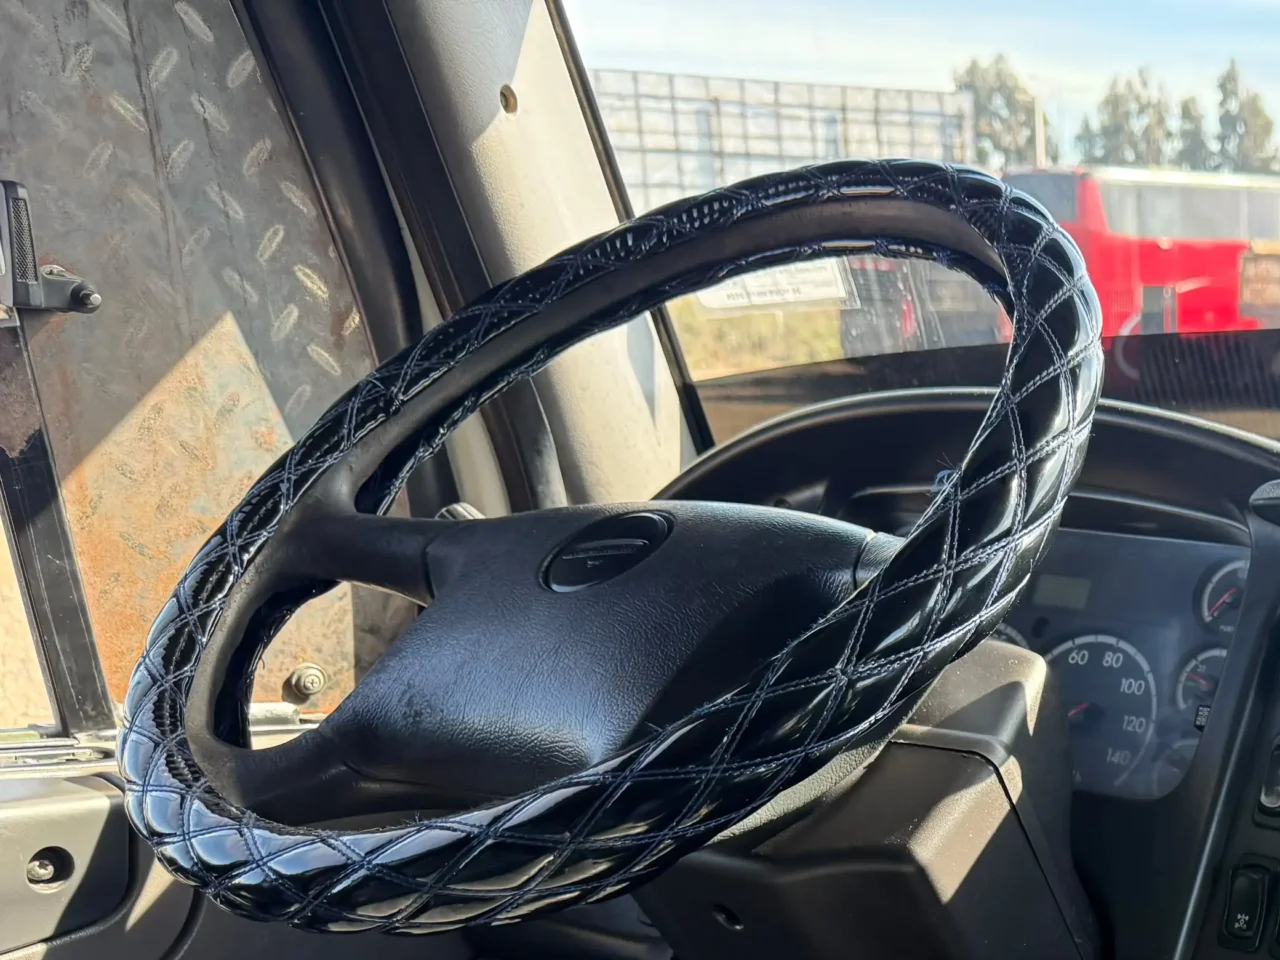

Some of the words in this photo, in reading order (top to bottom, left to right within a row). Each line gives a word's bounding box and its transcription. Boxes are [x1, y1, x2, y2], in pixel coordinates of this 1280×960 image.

[1068, 649, 1089, 665] 60
[1102, 652, 1123, 668] 80
[1120, 678, 1145, 695] 100
[1122, 715, 1146, 732] 120
[1106, 747, 1132, 765] 140
